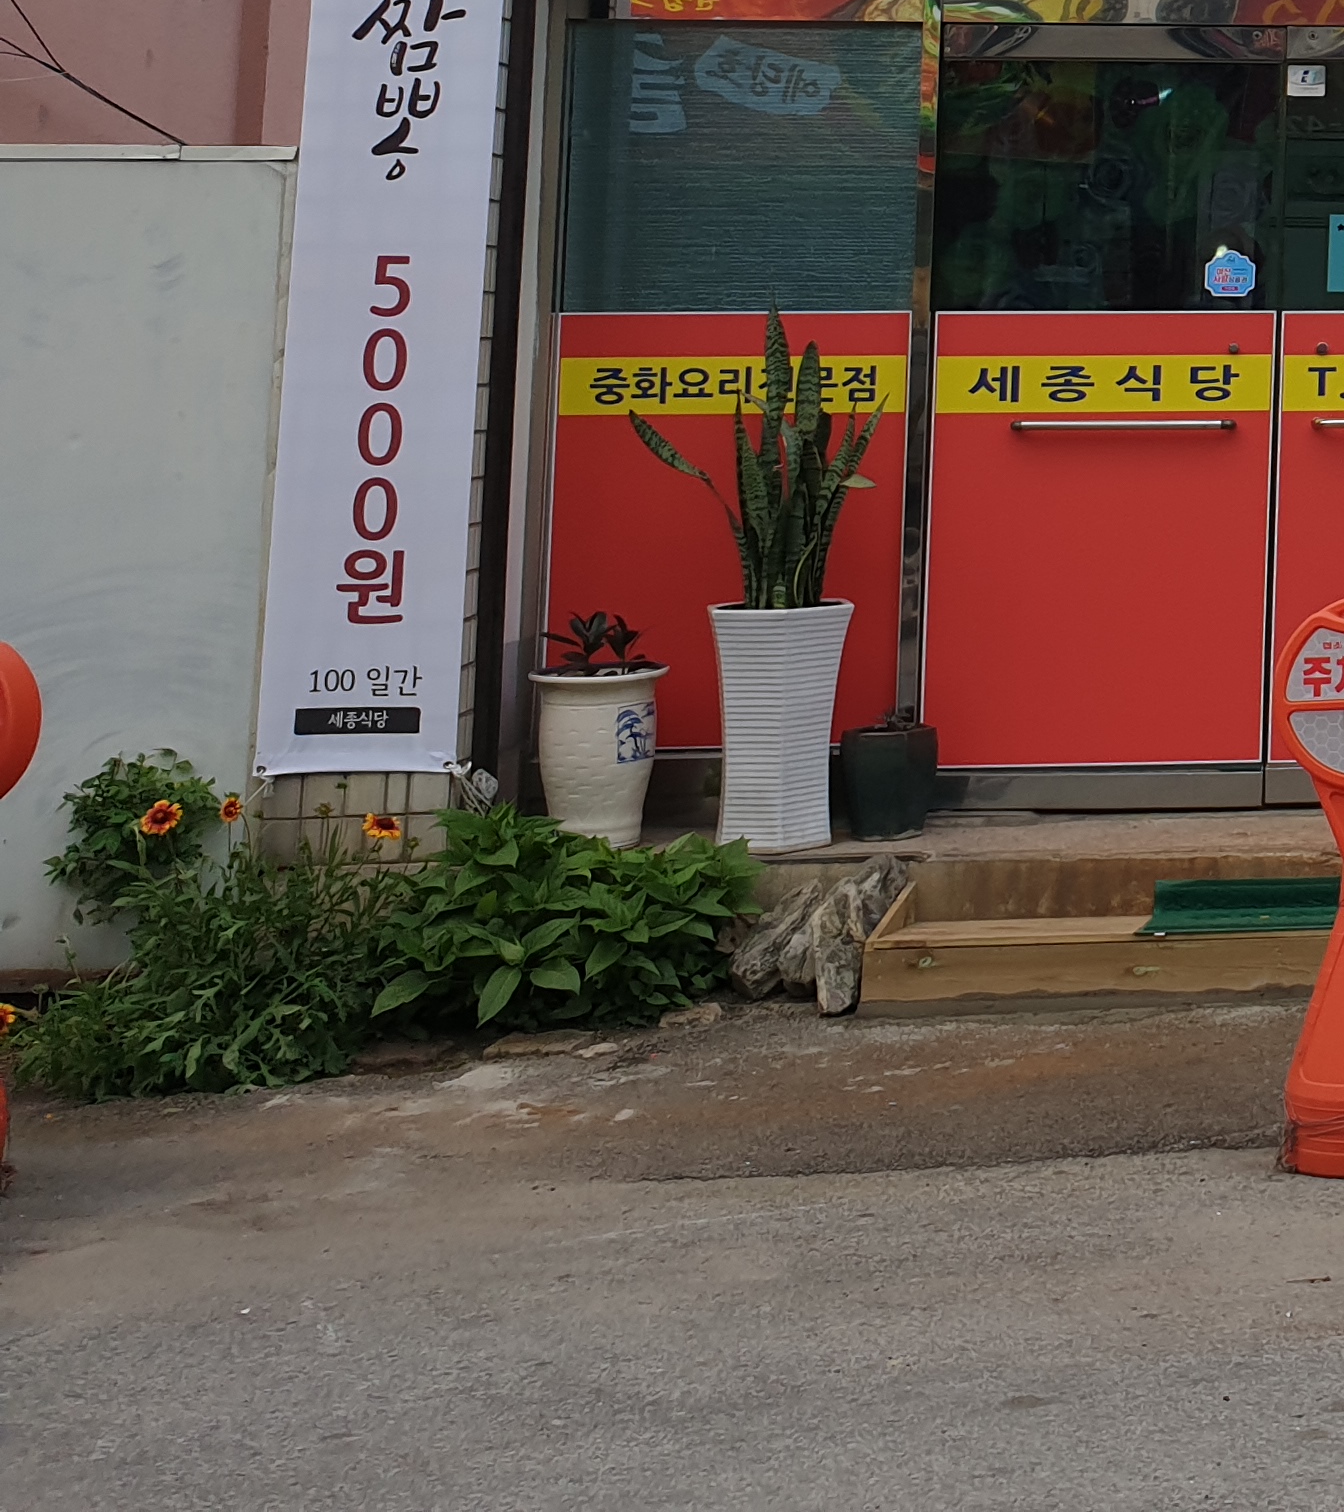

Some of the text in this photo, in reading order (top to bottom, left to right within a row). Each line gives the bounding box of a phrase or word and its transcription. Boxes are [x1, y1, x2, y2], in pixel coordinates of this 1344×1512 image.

[967, 364, 1240, 403] 세종식당
[335, 254, 411, 625] 5000원
[308, 665, 423, 698] 100 일간
[327, 710, 390, 730] 세종식당
